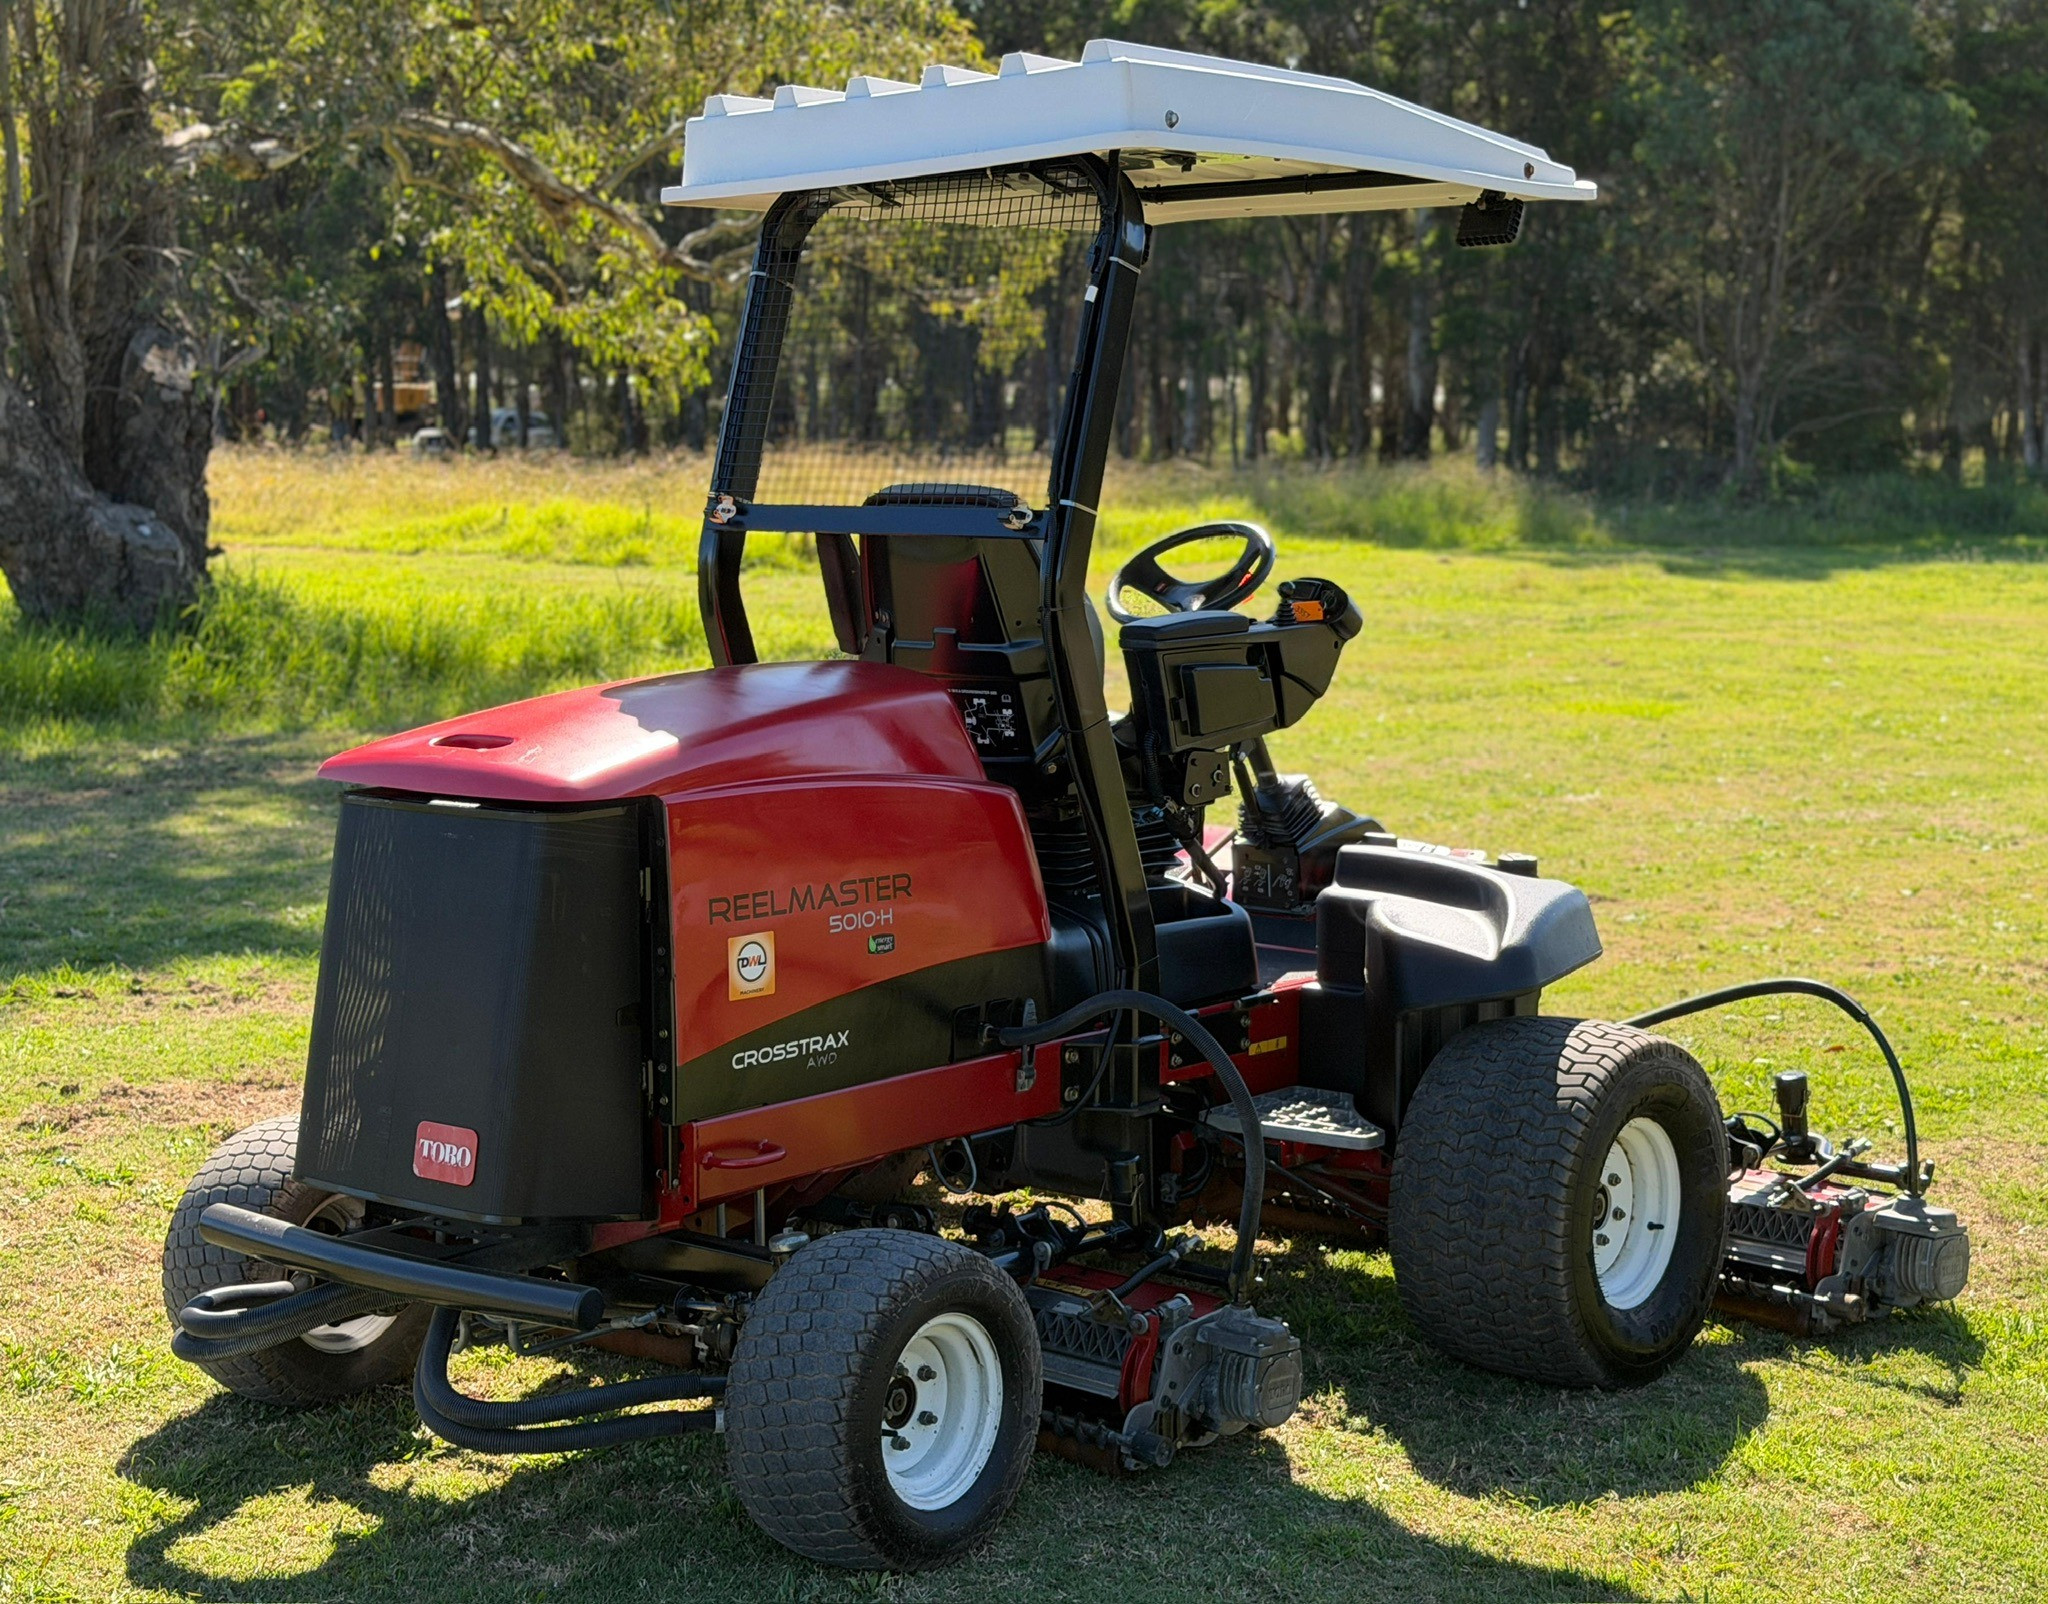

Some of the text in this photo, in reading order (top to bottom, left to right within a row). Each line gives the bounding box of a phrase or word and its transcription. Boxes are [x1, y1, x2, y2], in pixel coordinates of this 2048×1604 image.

[708, 873, 913, 925] REELMASTER
[738, 954, 766, 968] DWL
[740, 987, 765, 995] MACHINERY
[732, 1029, 850, 1070] CROSSTRAX
[806, 1051, 838, 1070] AWD
[419, 1138, 471, 1168] TORO
